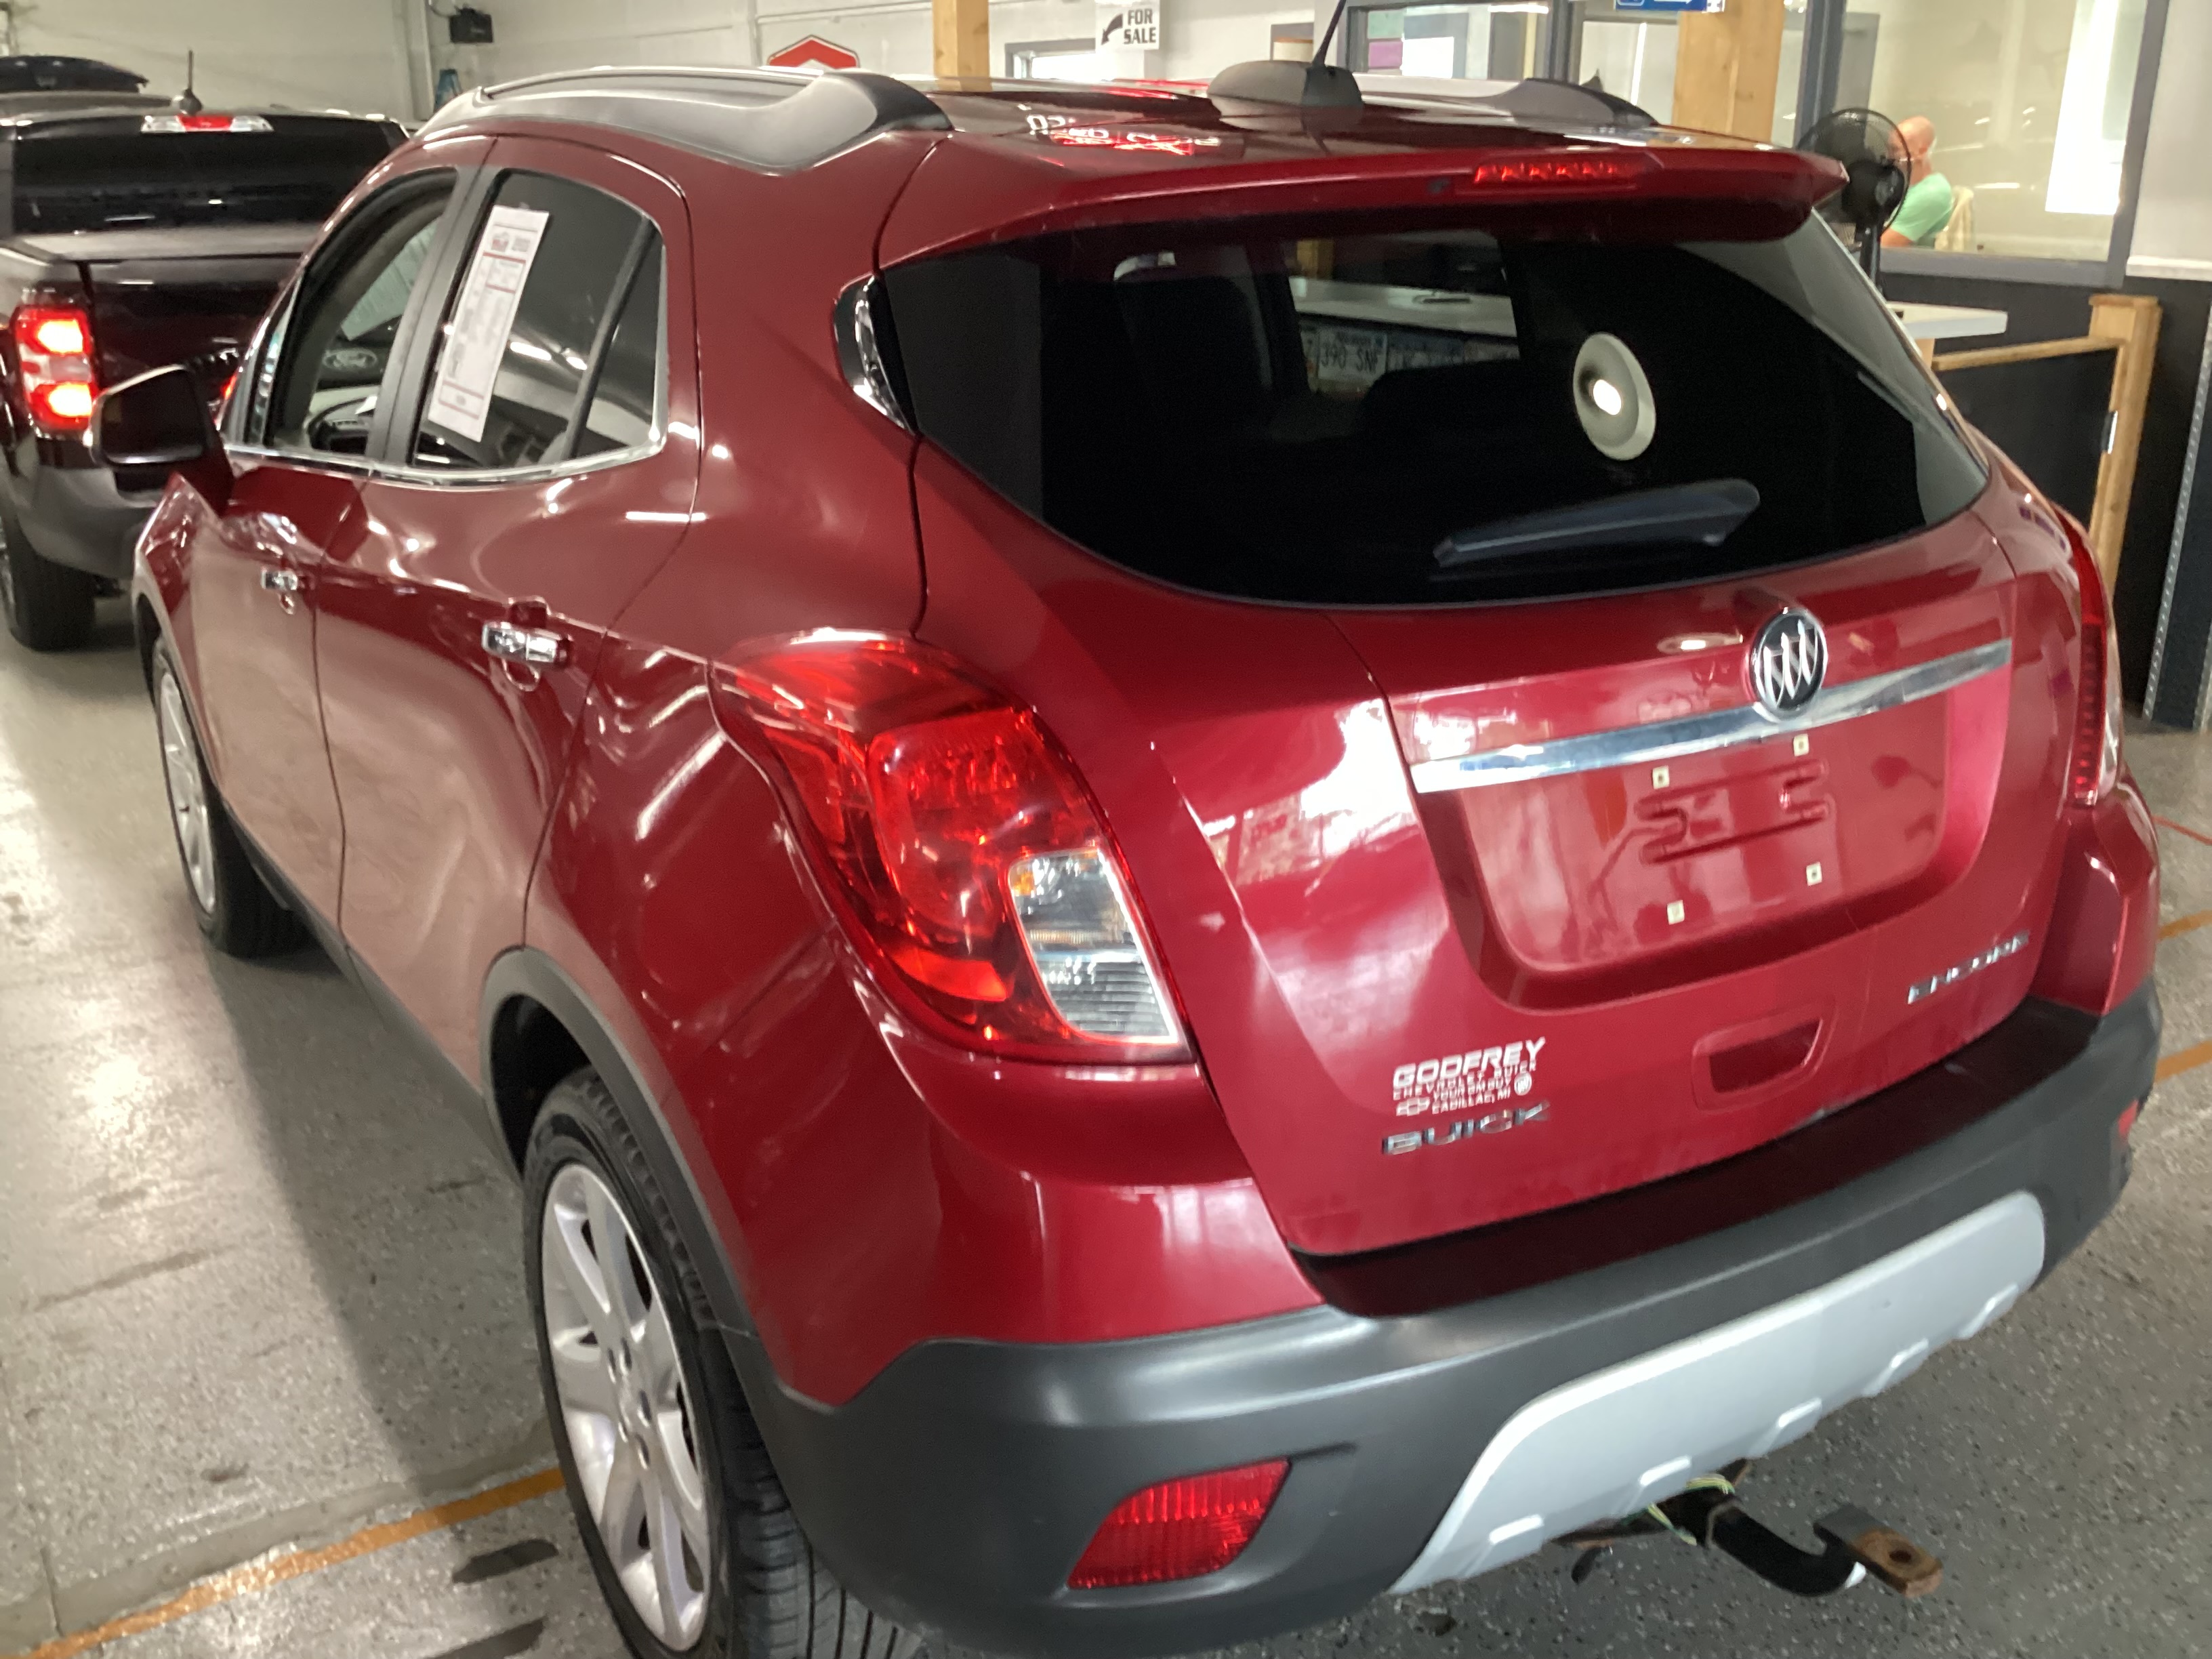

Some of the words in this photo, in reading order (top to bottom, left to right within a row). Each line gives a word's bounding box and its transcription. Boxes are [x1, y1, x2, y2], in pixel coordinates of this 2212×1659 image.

[1128, 8, 1153, 26] FOR
[1124, 27, 1157, 45] SALE
[1393, 1036, 1547, 1088] GODFREY
[1381, 1099, 1551, 1155] BUICK
